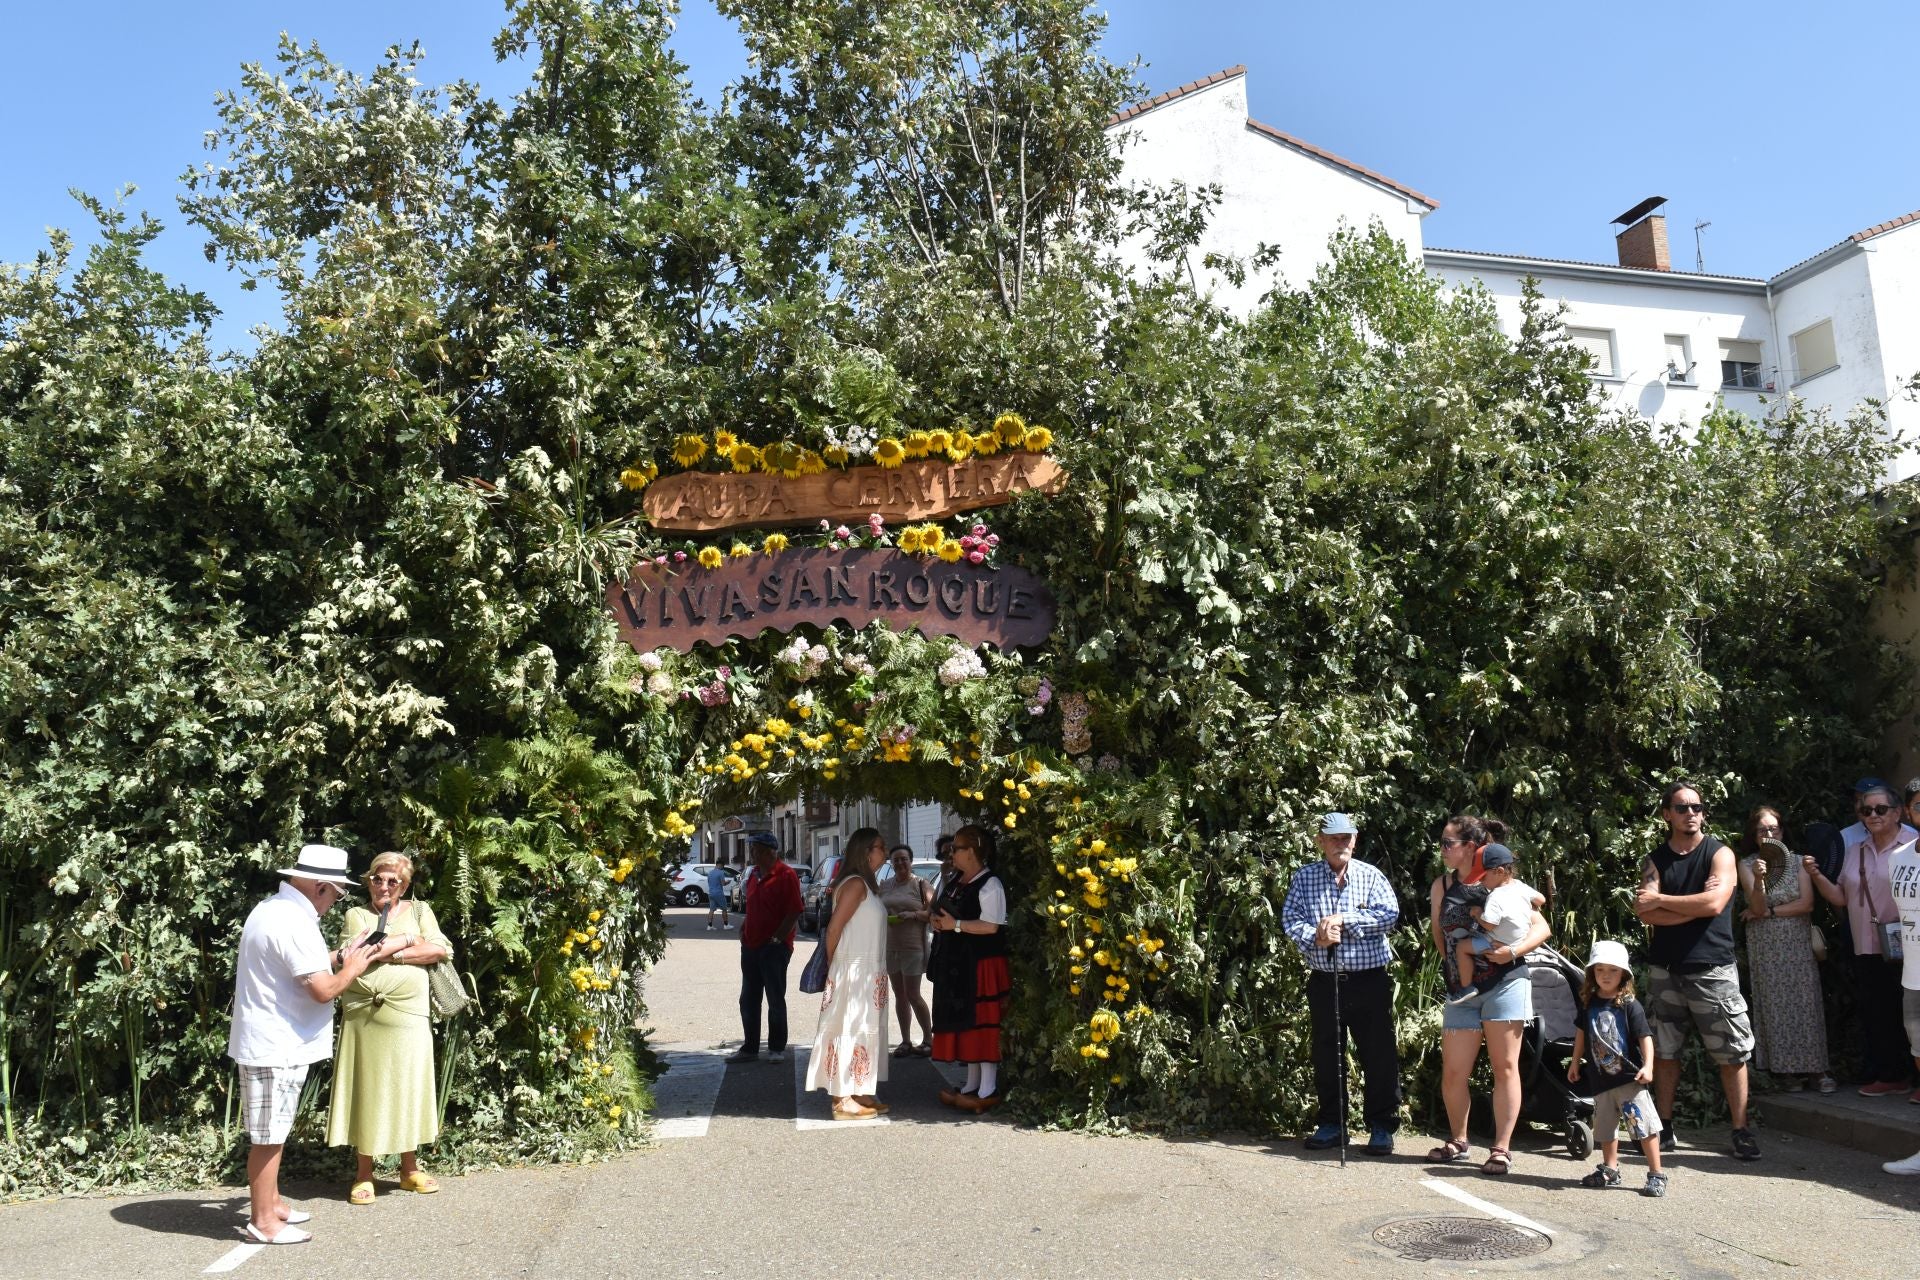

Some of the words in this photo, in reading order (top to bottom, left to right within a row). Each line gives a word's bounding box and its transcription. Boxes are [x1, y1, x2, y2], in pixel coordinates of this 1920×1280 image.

[660, 479, 796, 520] AUPA
[826, 453, 1034, 507] CERVERA
[622, 582, 755, 625] VIVA
[761, 566, 859, 606] SAN
[872, 570, 1034, 620] ROQUE
